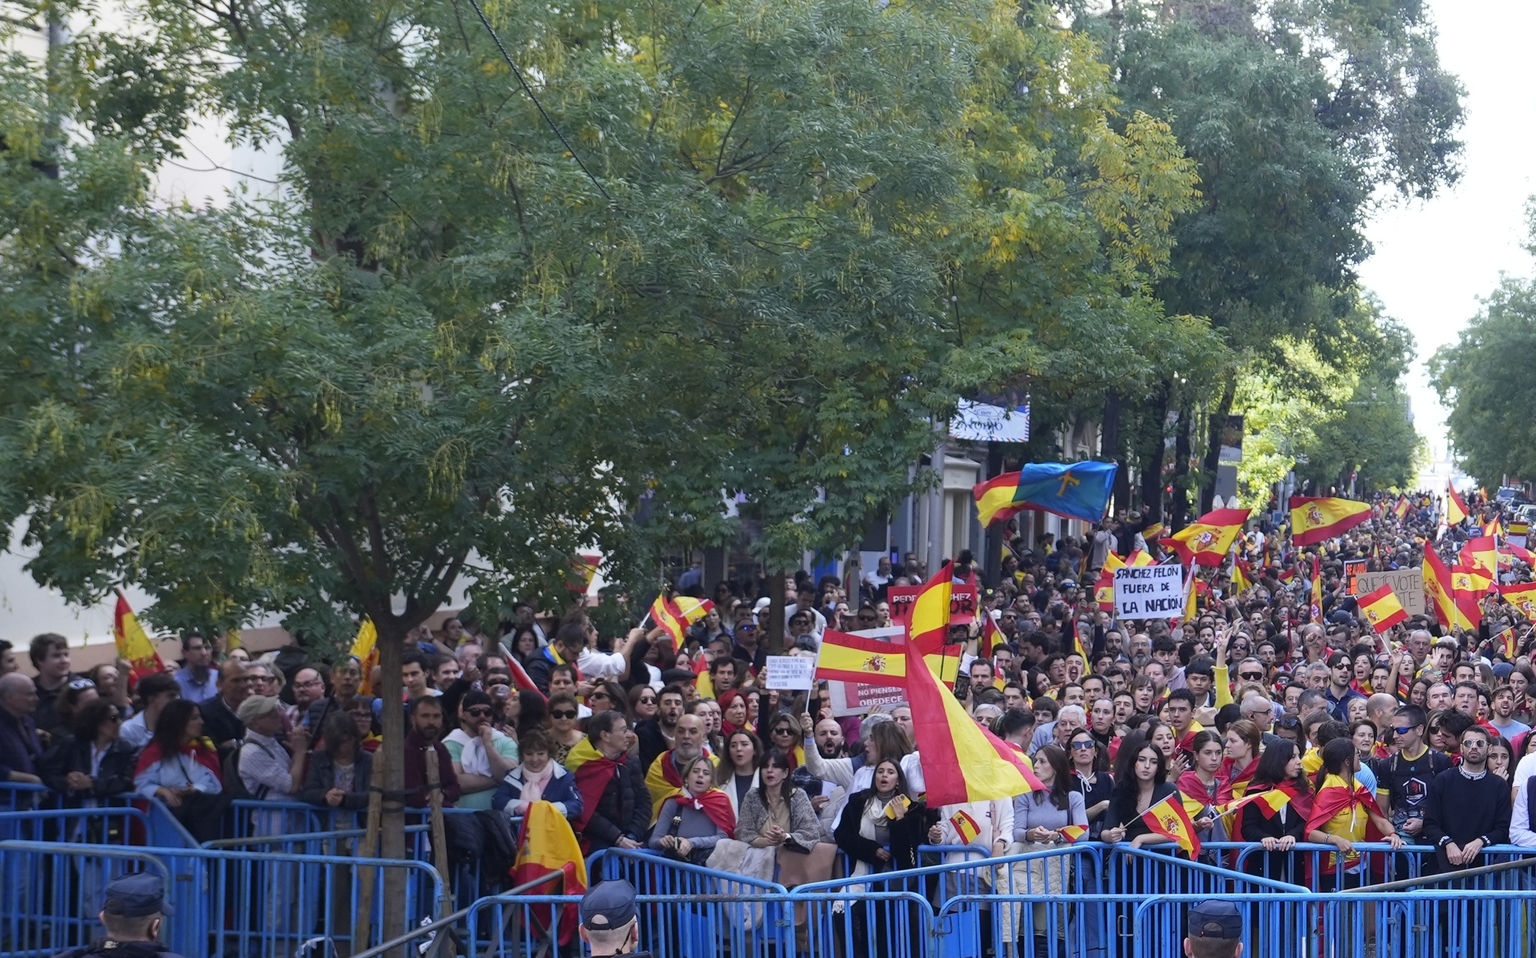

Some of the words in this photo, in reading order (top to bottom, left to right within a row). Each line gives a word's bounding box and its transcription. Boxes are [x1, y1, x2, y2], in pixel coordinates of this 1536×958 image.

[1123, 584, 1154, 594] FUERA
[1161, 582, 1170, 592] DE
[1392, 574, 1420, 591] VOTE
[1122, 602, 1138, 614] LA
[860, 696, 903, 706] OBEDECE
